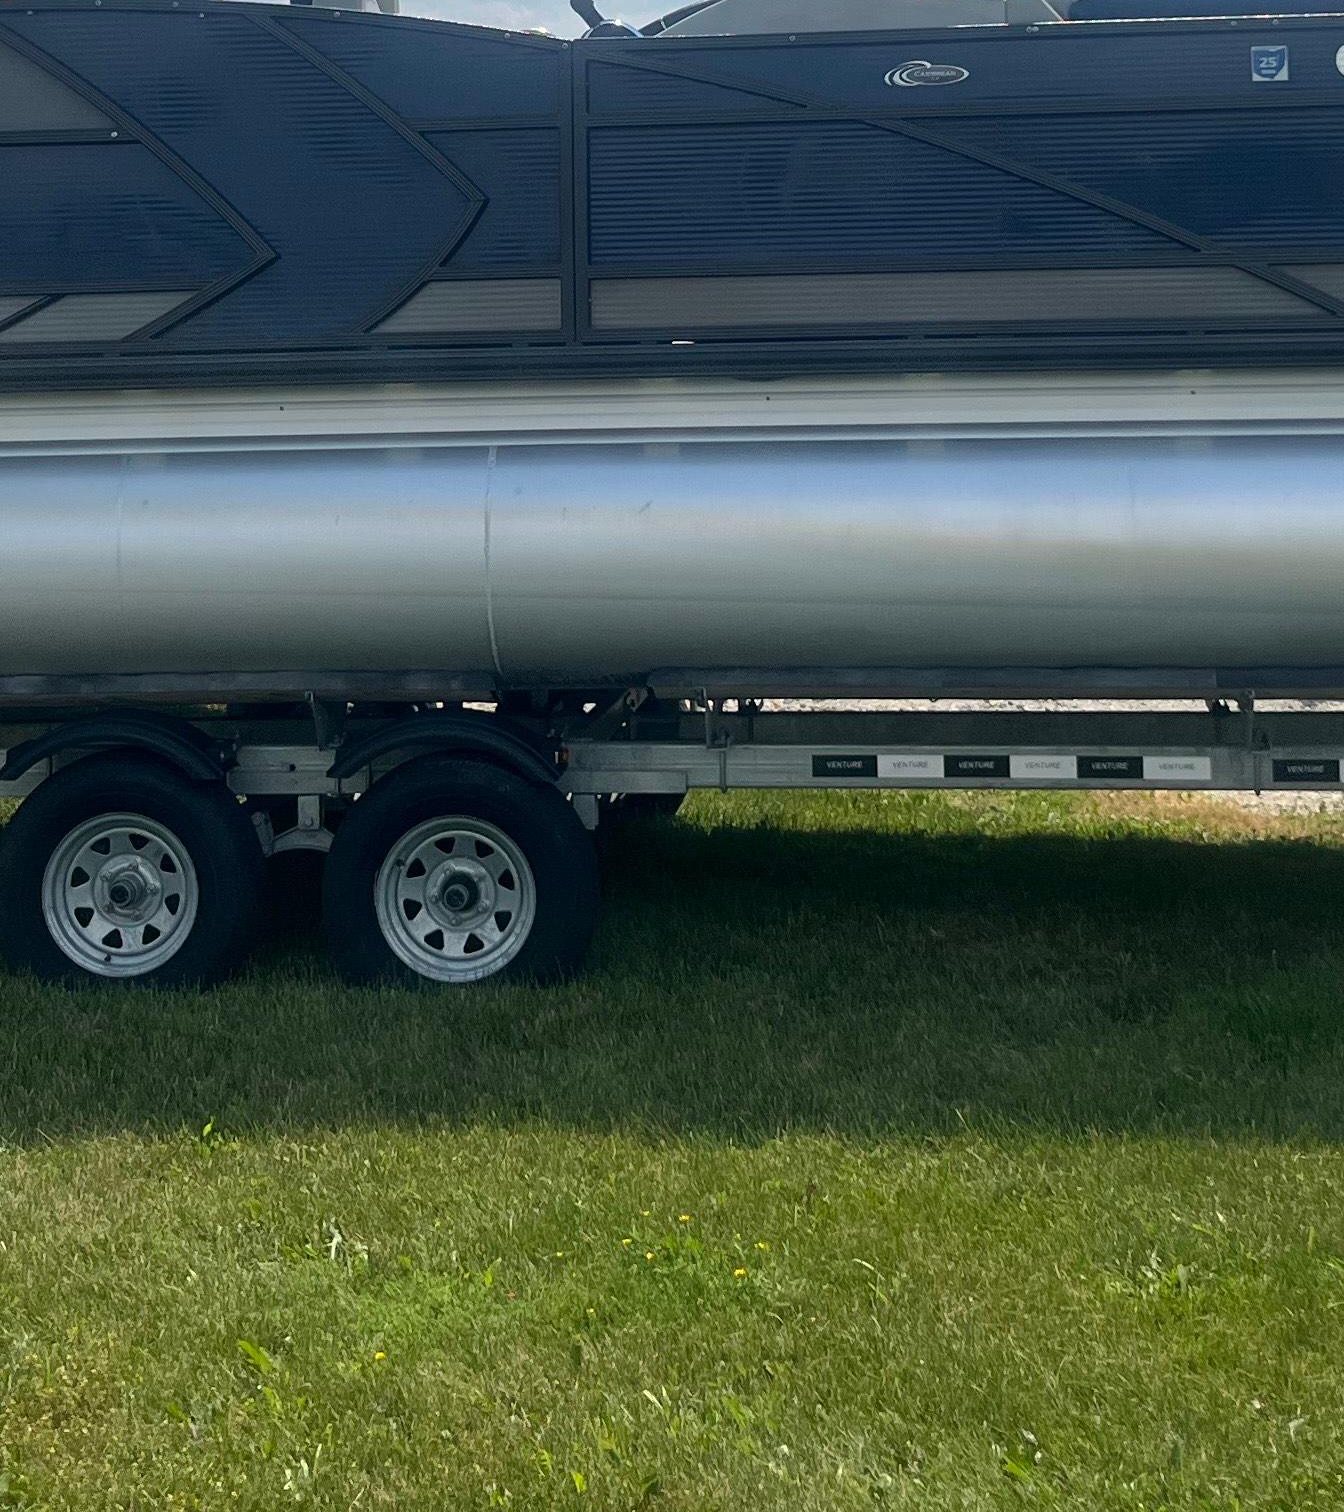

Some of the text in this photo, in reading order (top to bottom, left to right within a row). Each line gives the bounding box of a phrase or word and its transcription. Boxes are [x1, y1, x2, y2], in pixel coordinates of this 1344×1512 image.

[1259, 56, 1277, 68] 25
[826, 760, 863, 769] VENTURE
[892, 760, 929, 769] VENTURE
[958, 760, 995, 770] VENTURE
[1024, 761, 1061, 770] VENTURE
[1091, 761, 1129, 770] VENTURE
[1158, 763, 1195, 771] VENTURE
